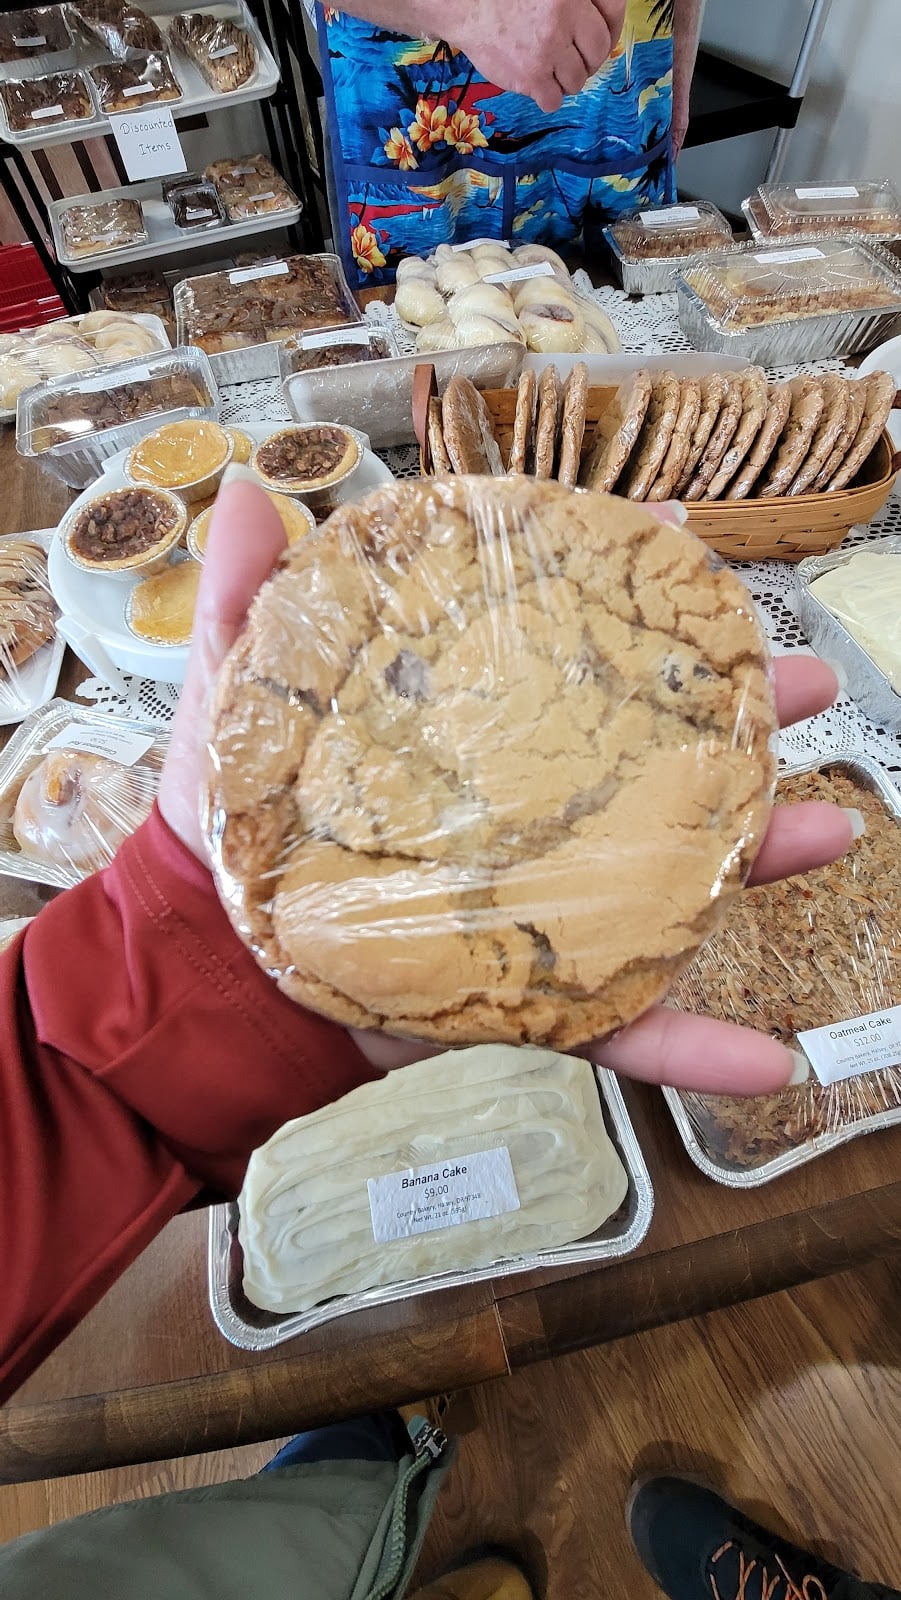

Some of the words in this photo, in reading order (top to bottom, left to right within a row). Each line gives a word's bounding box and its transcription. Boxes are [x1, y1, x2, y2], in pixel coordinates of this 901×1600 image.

[120, 113, 173, 135] Discounted
[139, 142, 171, 155] Items
[830, 1023, 867, 1040] Oatmeal
[869, 1017, 892, 1029] Cake
[854, 1033, 882, 1047] $12.00
[402, 1171, 439, 1189] Banana
[442, 1165, 467, 1179] Cake
[424, 1185, 448, 1199] $9.00
